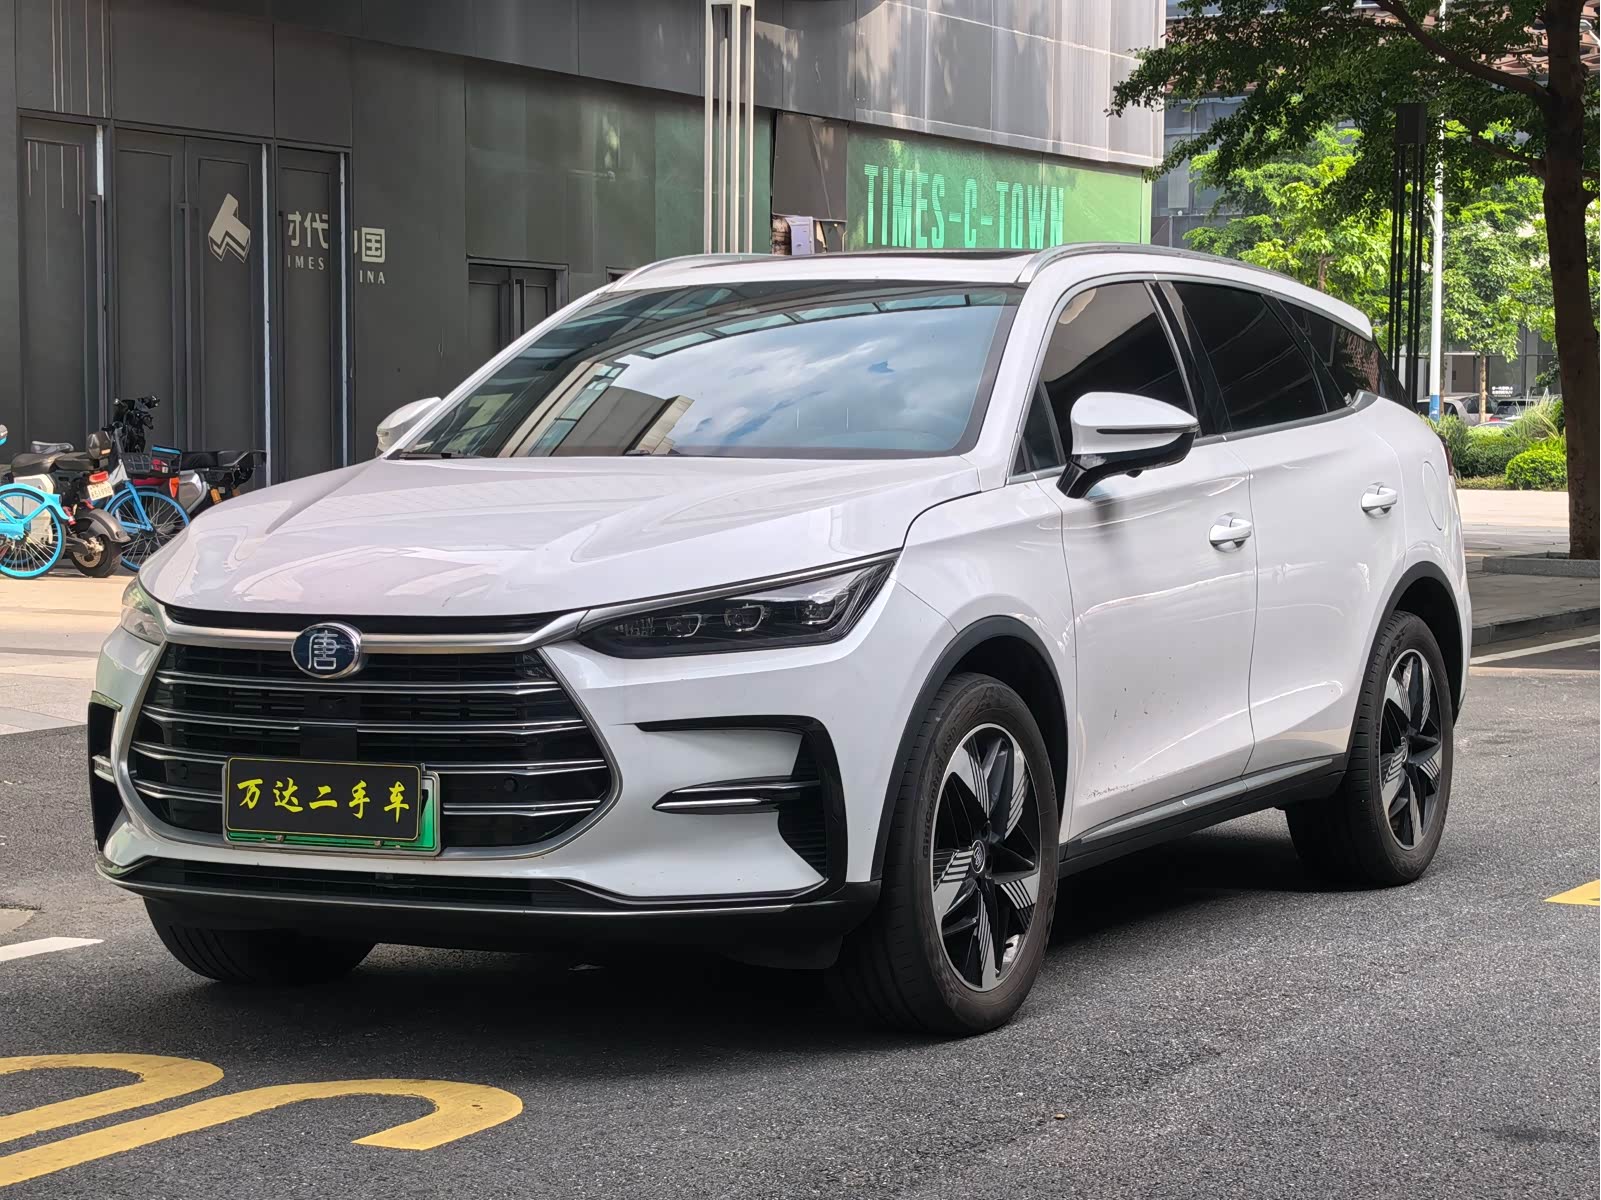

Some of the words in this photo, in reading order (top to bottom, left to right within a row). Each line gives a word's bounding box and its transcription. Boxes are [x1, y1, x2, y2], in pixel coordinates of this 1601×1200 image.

[864, 164, 1064, 249] TIMES-C-TOWN
[287, 254, 325, 271] IMES
[359, 269, 386, 285] INA
[307, 629, 341, 670] 唐
[236, 777, 410, 823] 万达二手车
